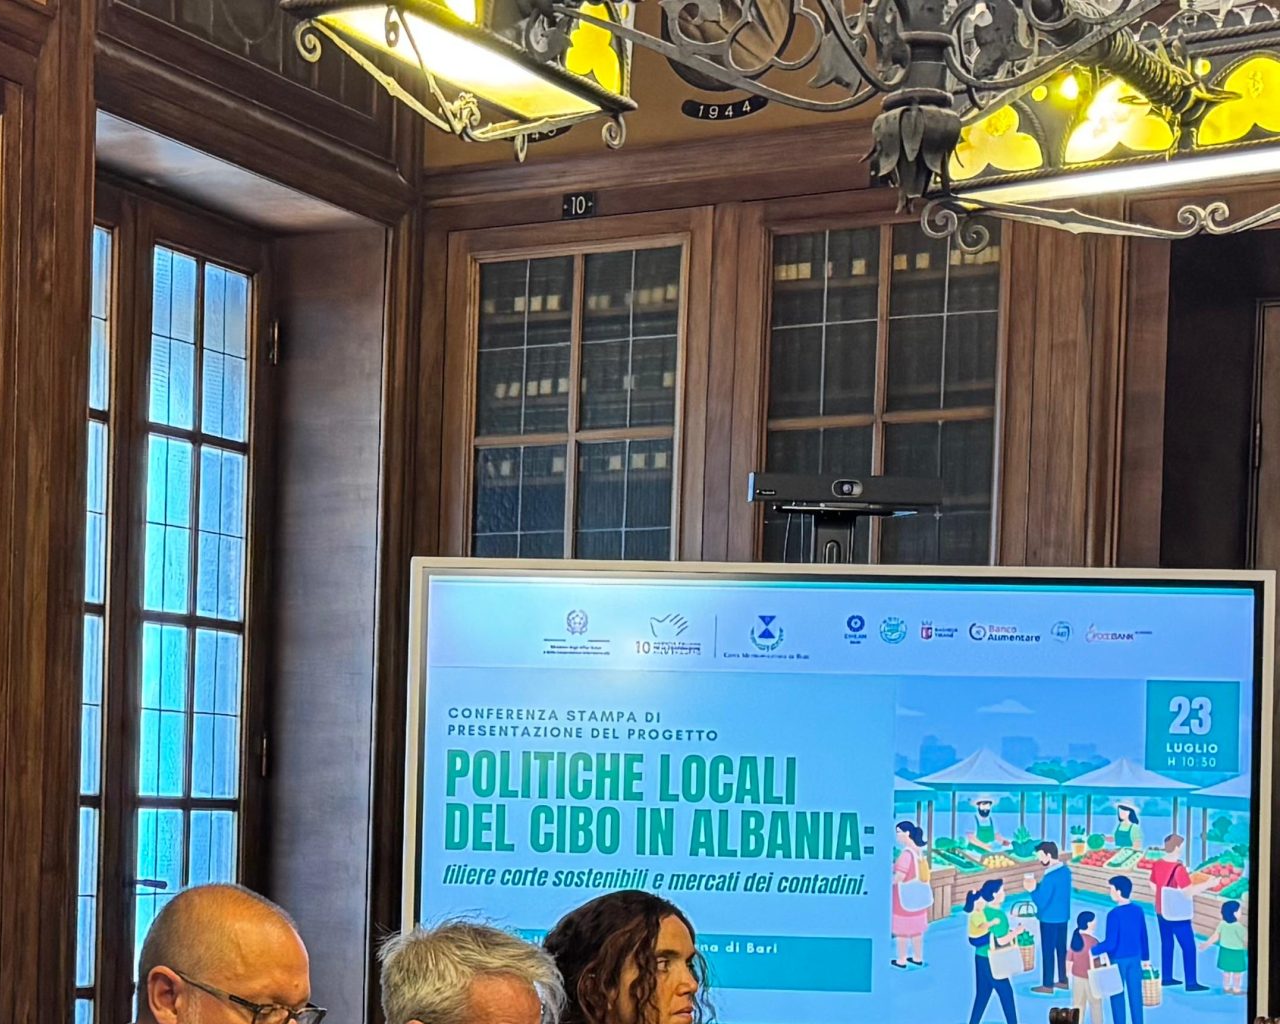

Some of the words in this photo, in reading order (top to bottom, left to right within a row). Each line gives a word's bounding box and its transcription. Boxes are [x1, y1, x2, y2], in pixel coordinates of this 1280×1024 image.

[697, 100, 752, 119] 1944
[571, 196, 586, 214] 10
[989, 624, 1017, 634] Banco
[987, 633, 1041, 643] Alimentare
[448, 707, 558, 721] CONFERENZA
[566, 710, 637, 722] STAMPA
[645, 712, 660, 723] DI
[1169, 695, 1212, 736] 23
[447, 724, 583, 738] PRESENTAZIONE
[591, 728, 619, 739] DEL
[627, 728, 718, 741] PROGETTO
[1166, 742, 1218, 754] LUGLIO
[1167, 757, 1176, 766] H
[446, 749, 643, 801] POLITICHE
[659, 753, 797, 806] LOCALI
[444, 802, 515, 852] DEL
[529, 804, 620, 856] CIBO
[636, 807, 674, 857] IN
[688, 809, 875, 861] ALBANIA:
[443, 864, 496, 885] filiere
[500, 867, 548, 887] corte
[552, 867, 650, 891] sostenibili
[652, 876, 664, 891] e
[668, 873, 740, 893] mercati
[743, 873, 773, 893] dei
[777, 875, 869, 896] contadini.
[725, 941, 740, 953] di
[746, 943, 778, 954] Bari
